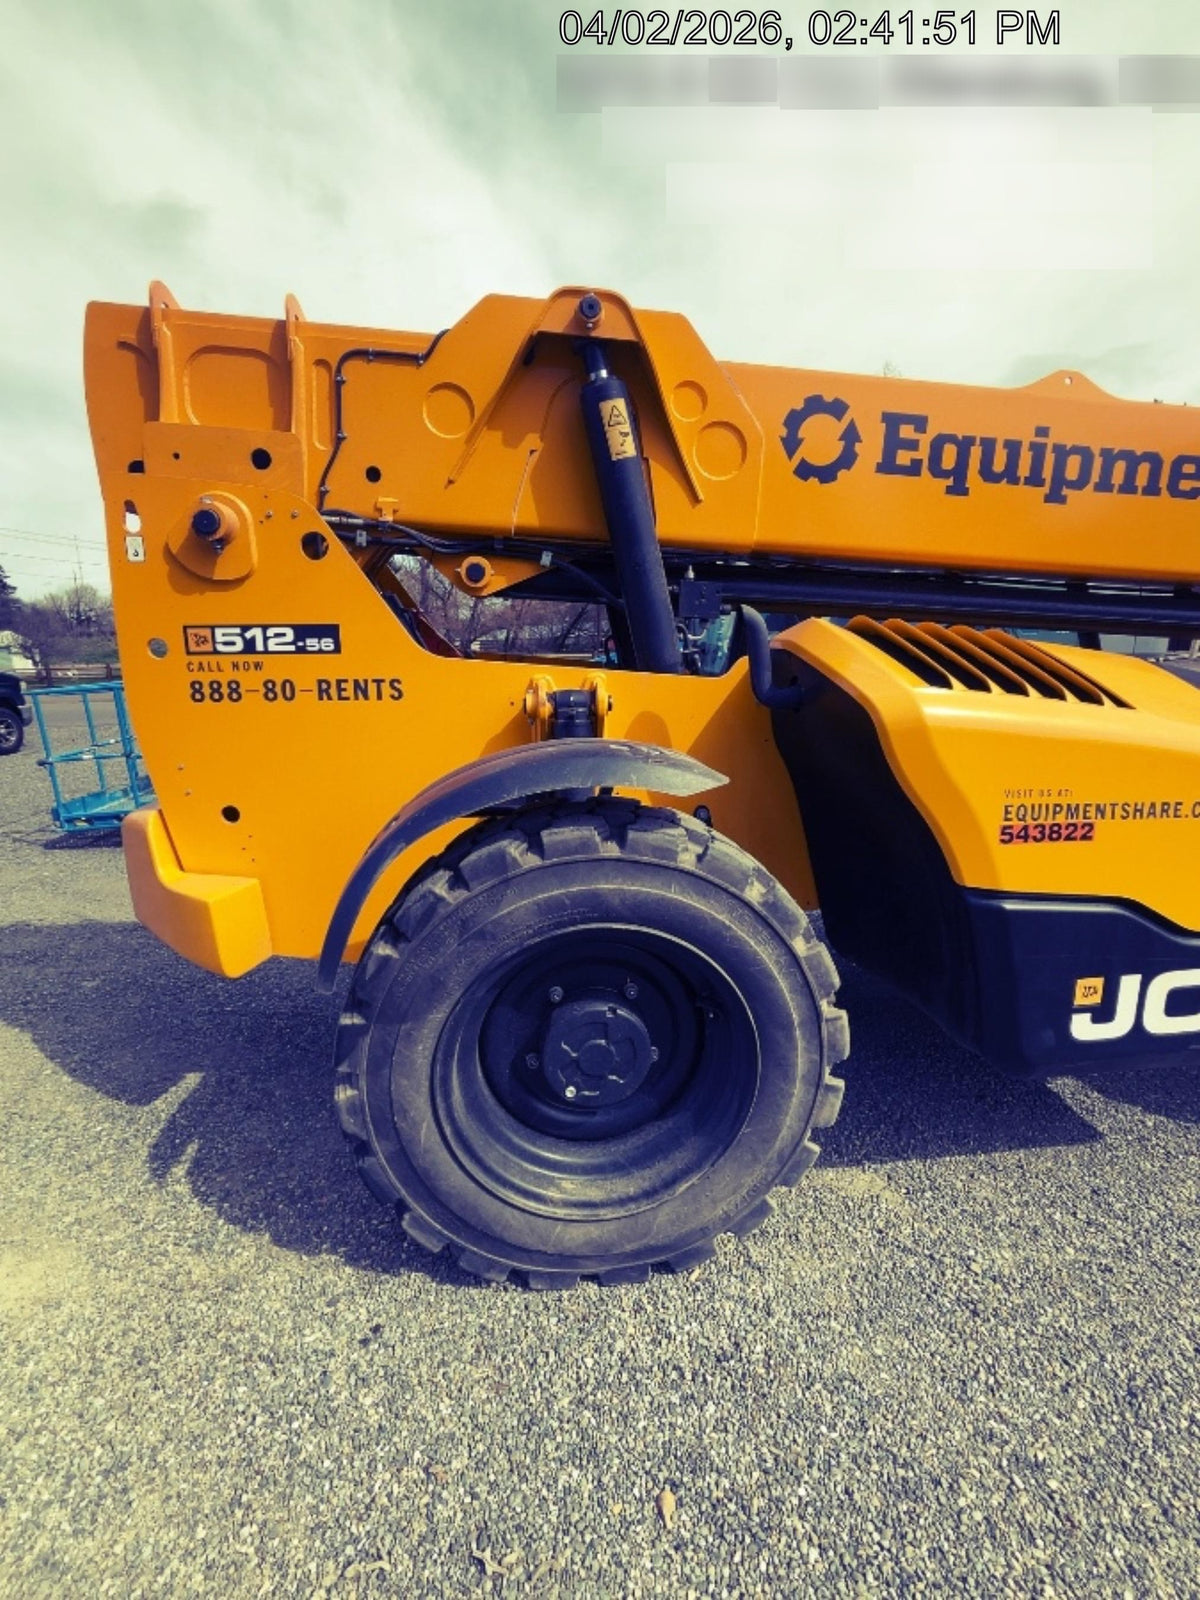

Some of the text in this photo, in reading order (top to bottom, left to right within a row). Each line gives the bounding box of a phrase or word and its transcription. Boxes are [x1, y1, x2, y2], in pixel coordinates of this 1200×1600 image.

[875, 411, 1200, 505] Equipme
[187, 660, 265, 673] CALL NOW
[189, 678, 404, 704] 888-80-RENTS
[1004, 788, 1034, 799] VISIT
[1038, 788, 1053, 798] US
[999, 822, 1094, 845] 543822
